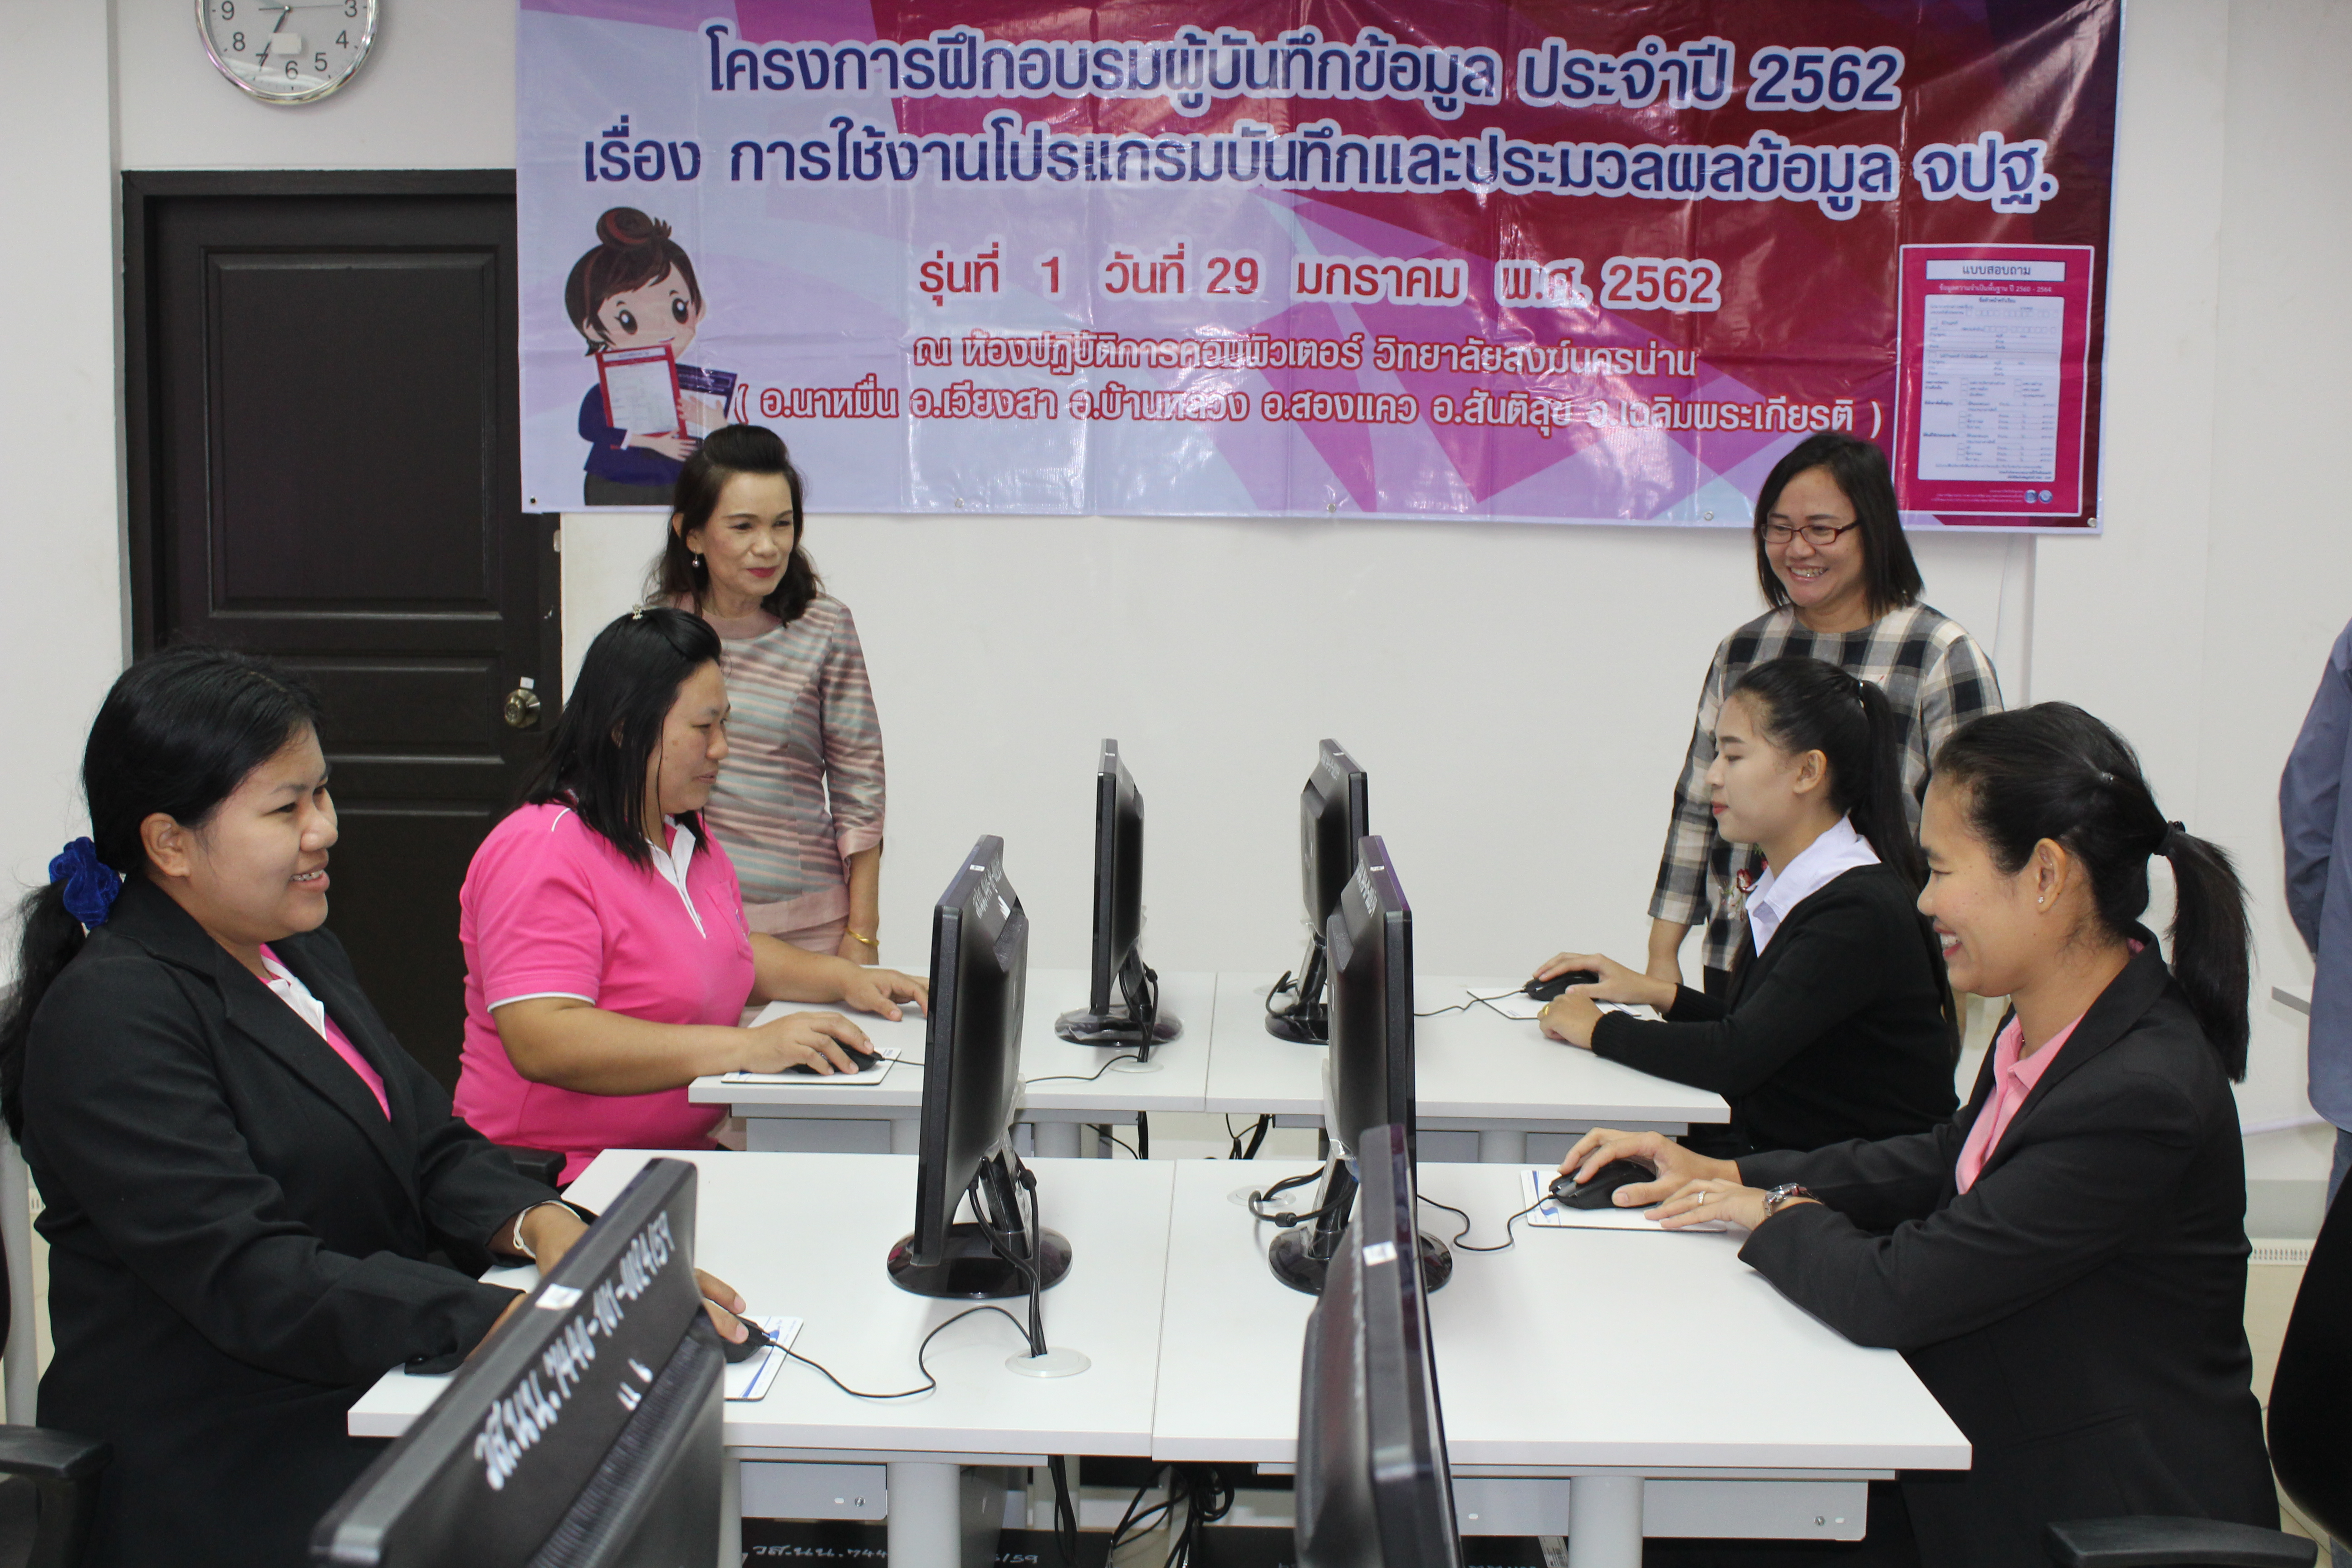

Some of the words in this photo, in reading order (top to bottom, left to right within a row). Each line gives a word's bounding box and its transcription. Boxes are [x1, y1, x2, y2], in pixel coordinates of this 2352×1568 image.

[221, 1, 235, 20] 9
[344, 0, 358, 17] 3
[233, 32, 245, 51] 8
[336, 30, 349, 49] 4
[285, 60, 298, 79] 6
[314, 52, 328, 71] 5
[705, 24, 1494, 110] โครงการฝึกอบรมผู้บันทึกข้อมูล
[1525, 43, 1727, 103] ประจำปี
[1754, 54, 1897, 103] 2562
[585, 114, 701, 181] เรื่อง
[731, 116, 1892, 212] การใช้งานโปรแกรมบันทึกและประมวลผลข้อมูล
[1921, 139, 2051, 204] จปฐ.
[920, 242, 998, 307] รุ่นที่
[1041, 256, 1058, 293] 1
[1105, 243, 1184, 294] วันที่
[1207, 257, 1259, 294] 29
[1297, 261, 1460, 298] มกราคม
[1502, 265, 1587, 299] พ.ศ.
[1608, 264, 1713, 304] 2562
[1963, 265, 2031, 275] แบบสอบถาม
[913, 337, 952, 366] ณ
[962, 328, 1365, 375] ห้องปฏิบัติการคอมพิวเตอร์
[1374, 336, 1697, 376] วิทยาลัยสงฆ์นครน่าน
[760, 373, 899, 418] อ.นาหมื่น
[910, 380, 1058, 418] อ.เวียงสา
[1069, 382, 1250, 421] อ.บ้านหลวง
[1262, 391, 1419, 425] อ.สองแคว
[1586, 395, 1855, 432] อ.เฉลิมพระเกียรติ
